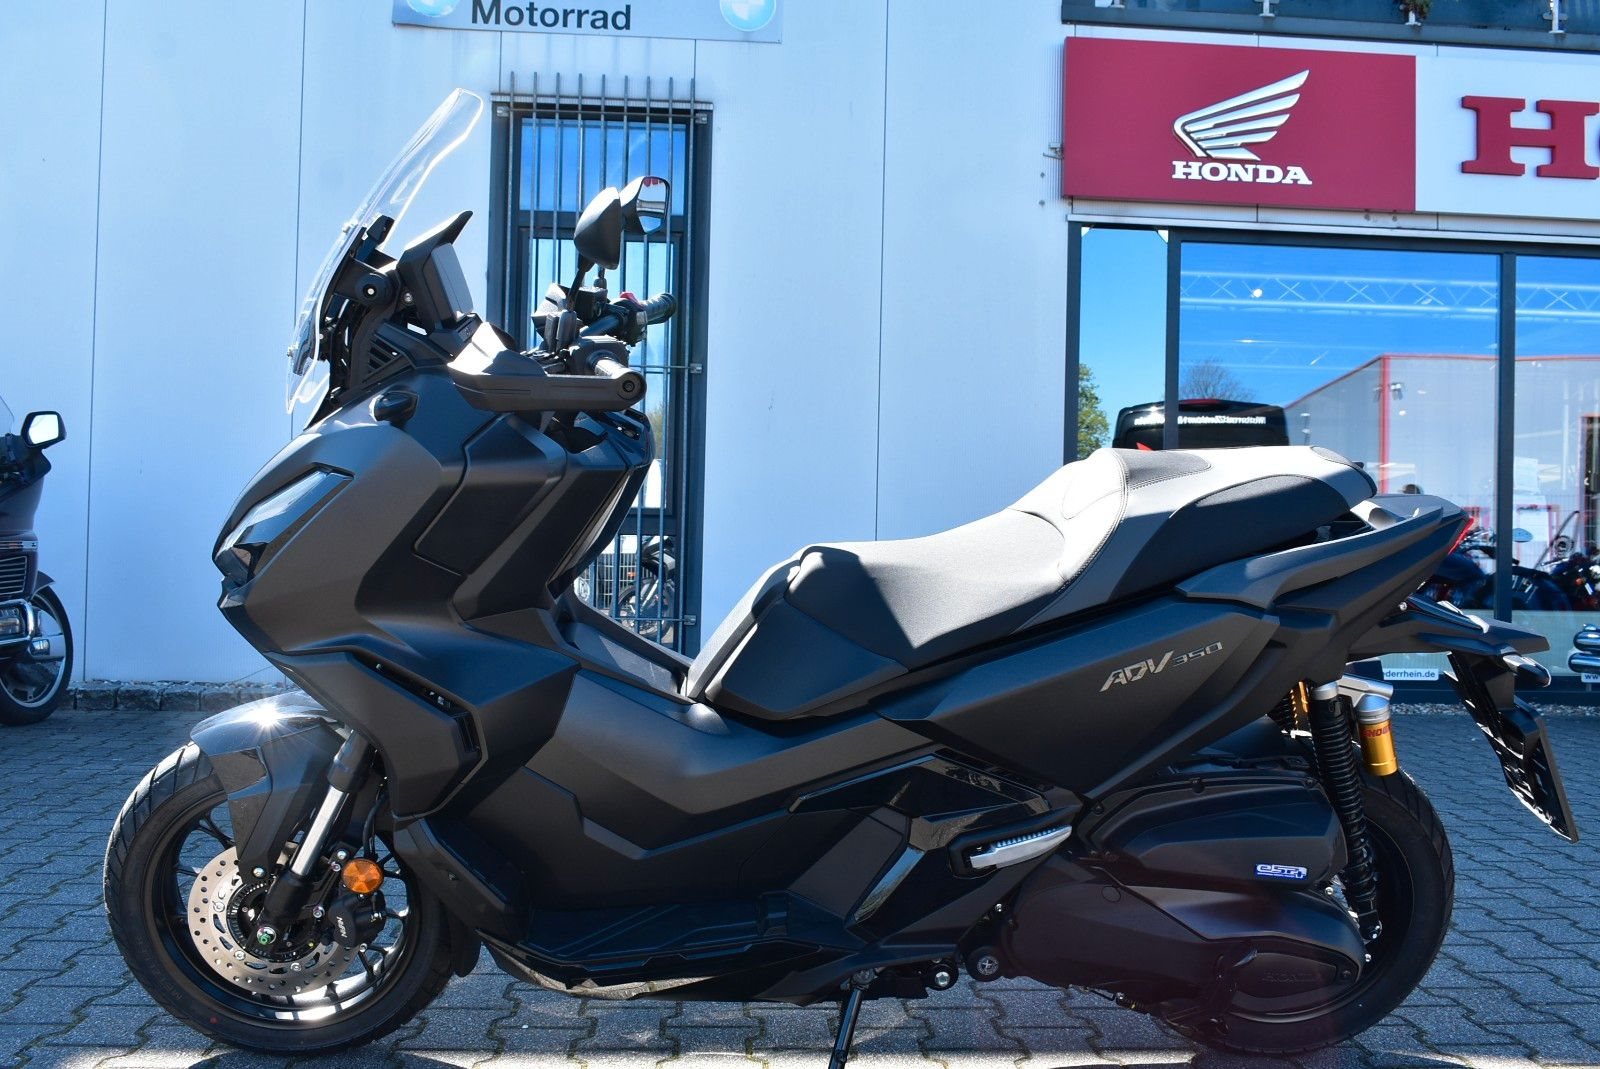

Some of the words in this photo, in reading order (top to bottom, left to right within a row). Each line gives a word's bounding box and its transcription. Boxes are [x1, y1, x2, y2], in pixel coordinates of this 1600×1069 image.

[471, 0, 631, 31] Motorrad
[1461, 95, 1600, 180] H
[1172, 161, 1312, 185] HONDA
[1099, 650, 1174, 692] ADV
[1172, 641, 1223, 667] 350
[1384, 669, 1436, 678] derrhein.de
